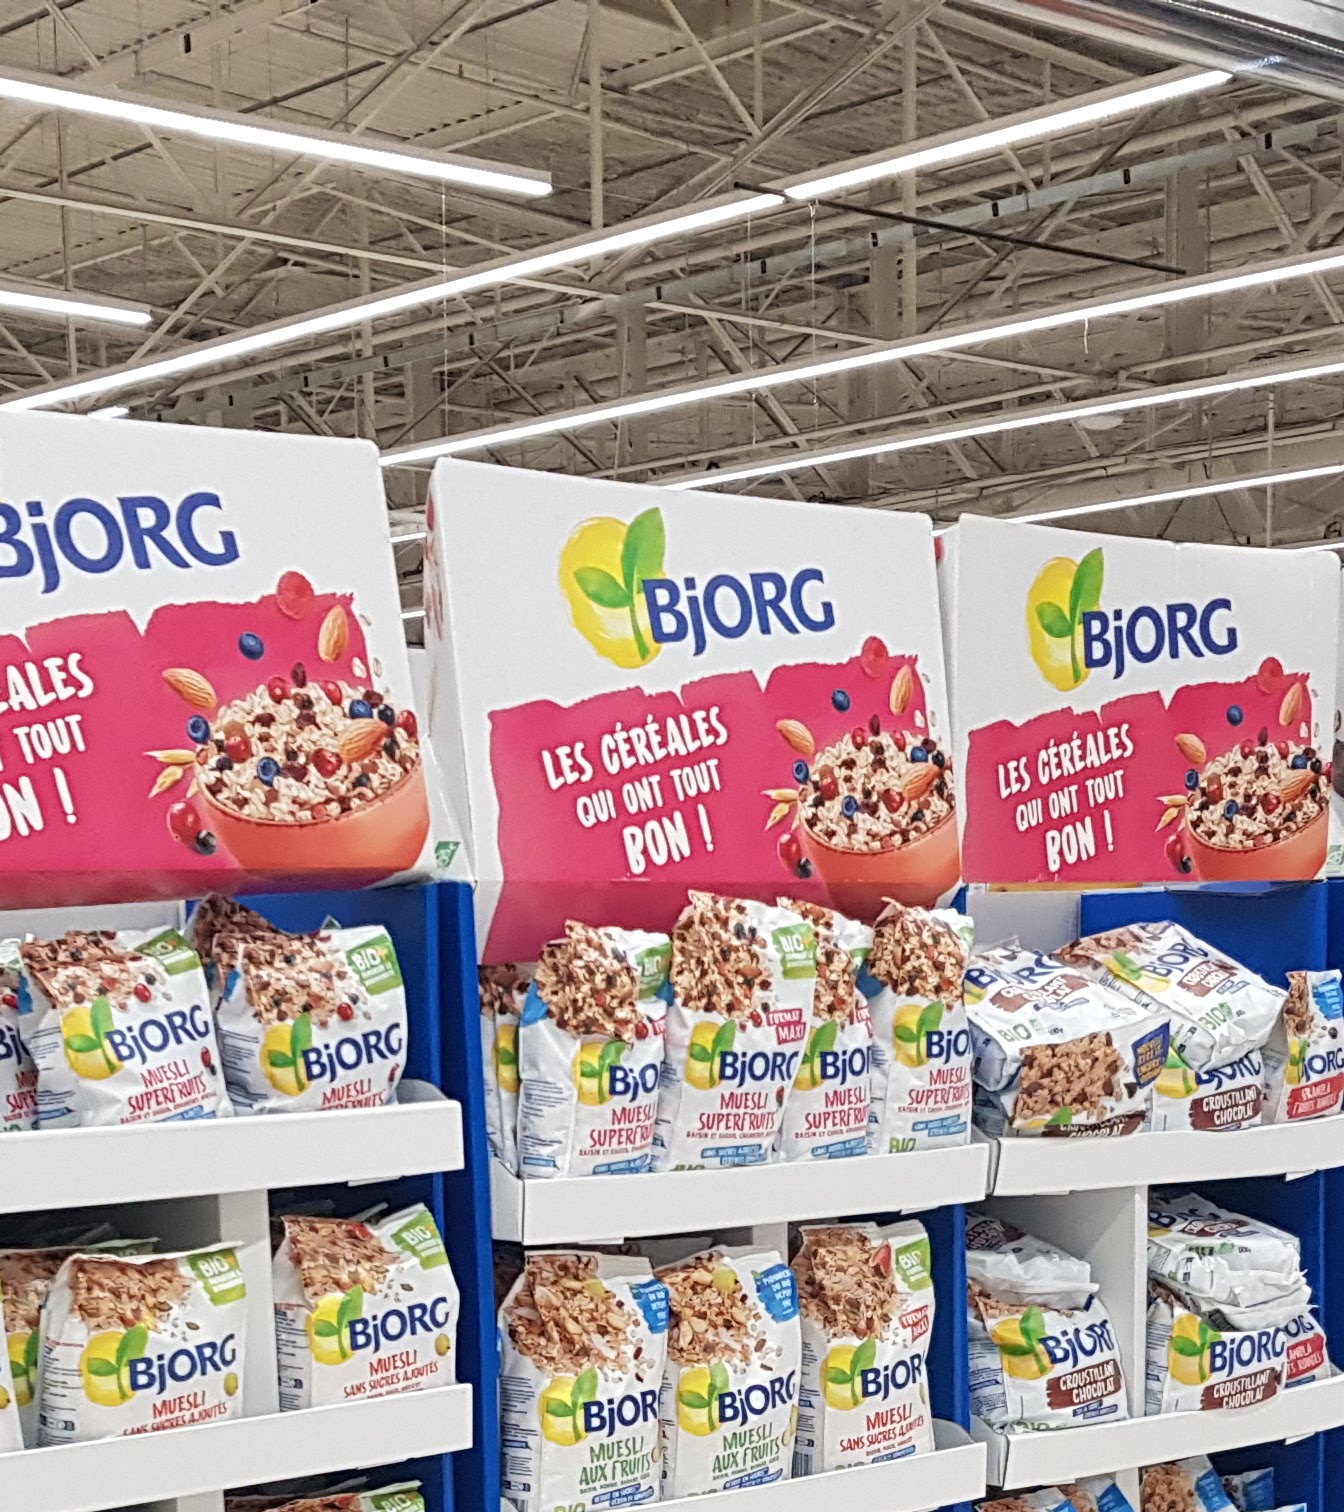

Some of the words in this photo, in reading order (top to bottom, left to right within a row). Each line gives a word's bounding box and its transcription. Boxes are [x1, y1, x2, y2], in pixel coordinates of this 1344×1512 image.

[14, 715, 88, 765] TOUT
[541, 741, 592, 789] LES
[600, 706, 729, 772] CÉRÉALES
[998, 755, 1031, 800] LES
[1037, 723, 1134, 780] CÉRÉALES
[576, 788, 616, 829] QUI
[623, 774, 664, 810] ONT
[670, 759, 721, 799] TOUT
[1016, 793, 1044, 833] QUI
[1049, 780, 1080, 819] ONT
[1085, 768, 1125, 806] TOUT
[623, 814, 692, 876] BON
[1046, 822, 1096, 871] BON
[128, 1078, 206, 1116] SUPERFRUITS
[141, 1063, 190, 1088] MUESLI
[699, 1112, 776, 1131] SUPERFRUITS
[720, 1092, 768, 1110] MUESLI
[369, 1350, 417, 1378] MUESLI
[713, 1450, 740, 1473] AUX
[743, 1439, 780, 1467] FRUITS
[723, 1422, 772, 1452] MUESLI
